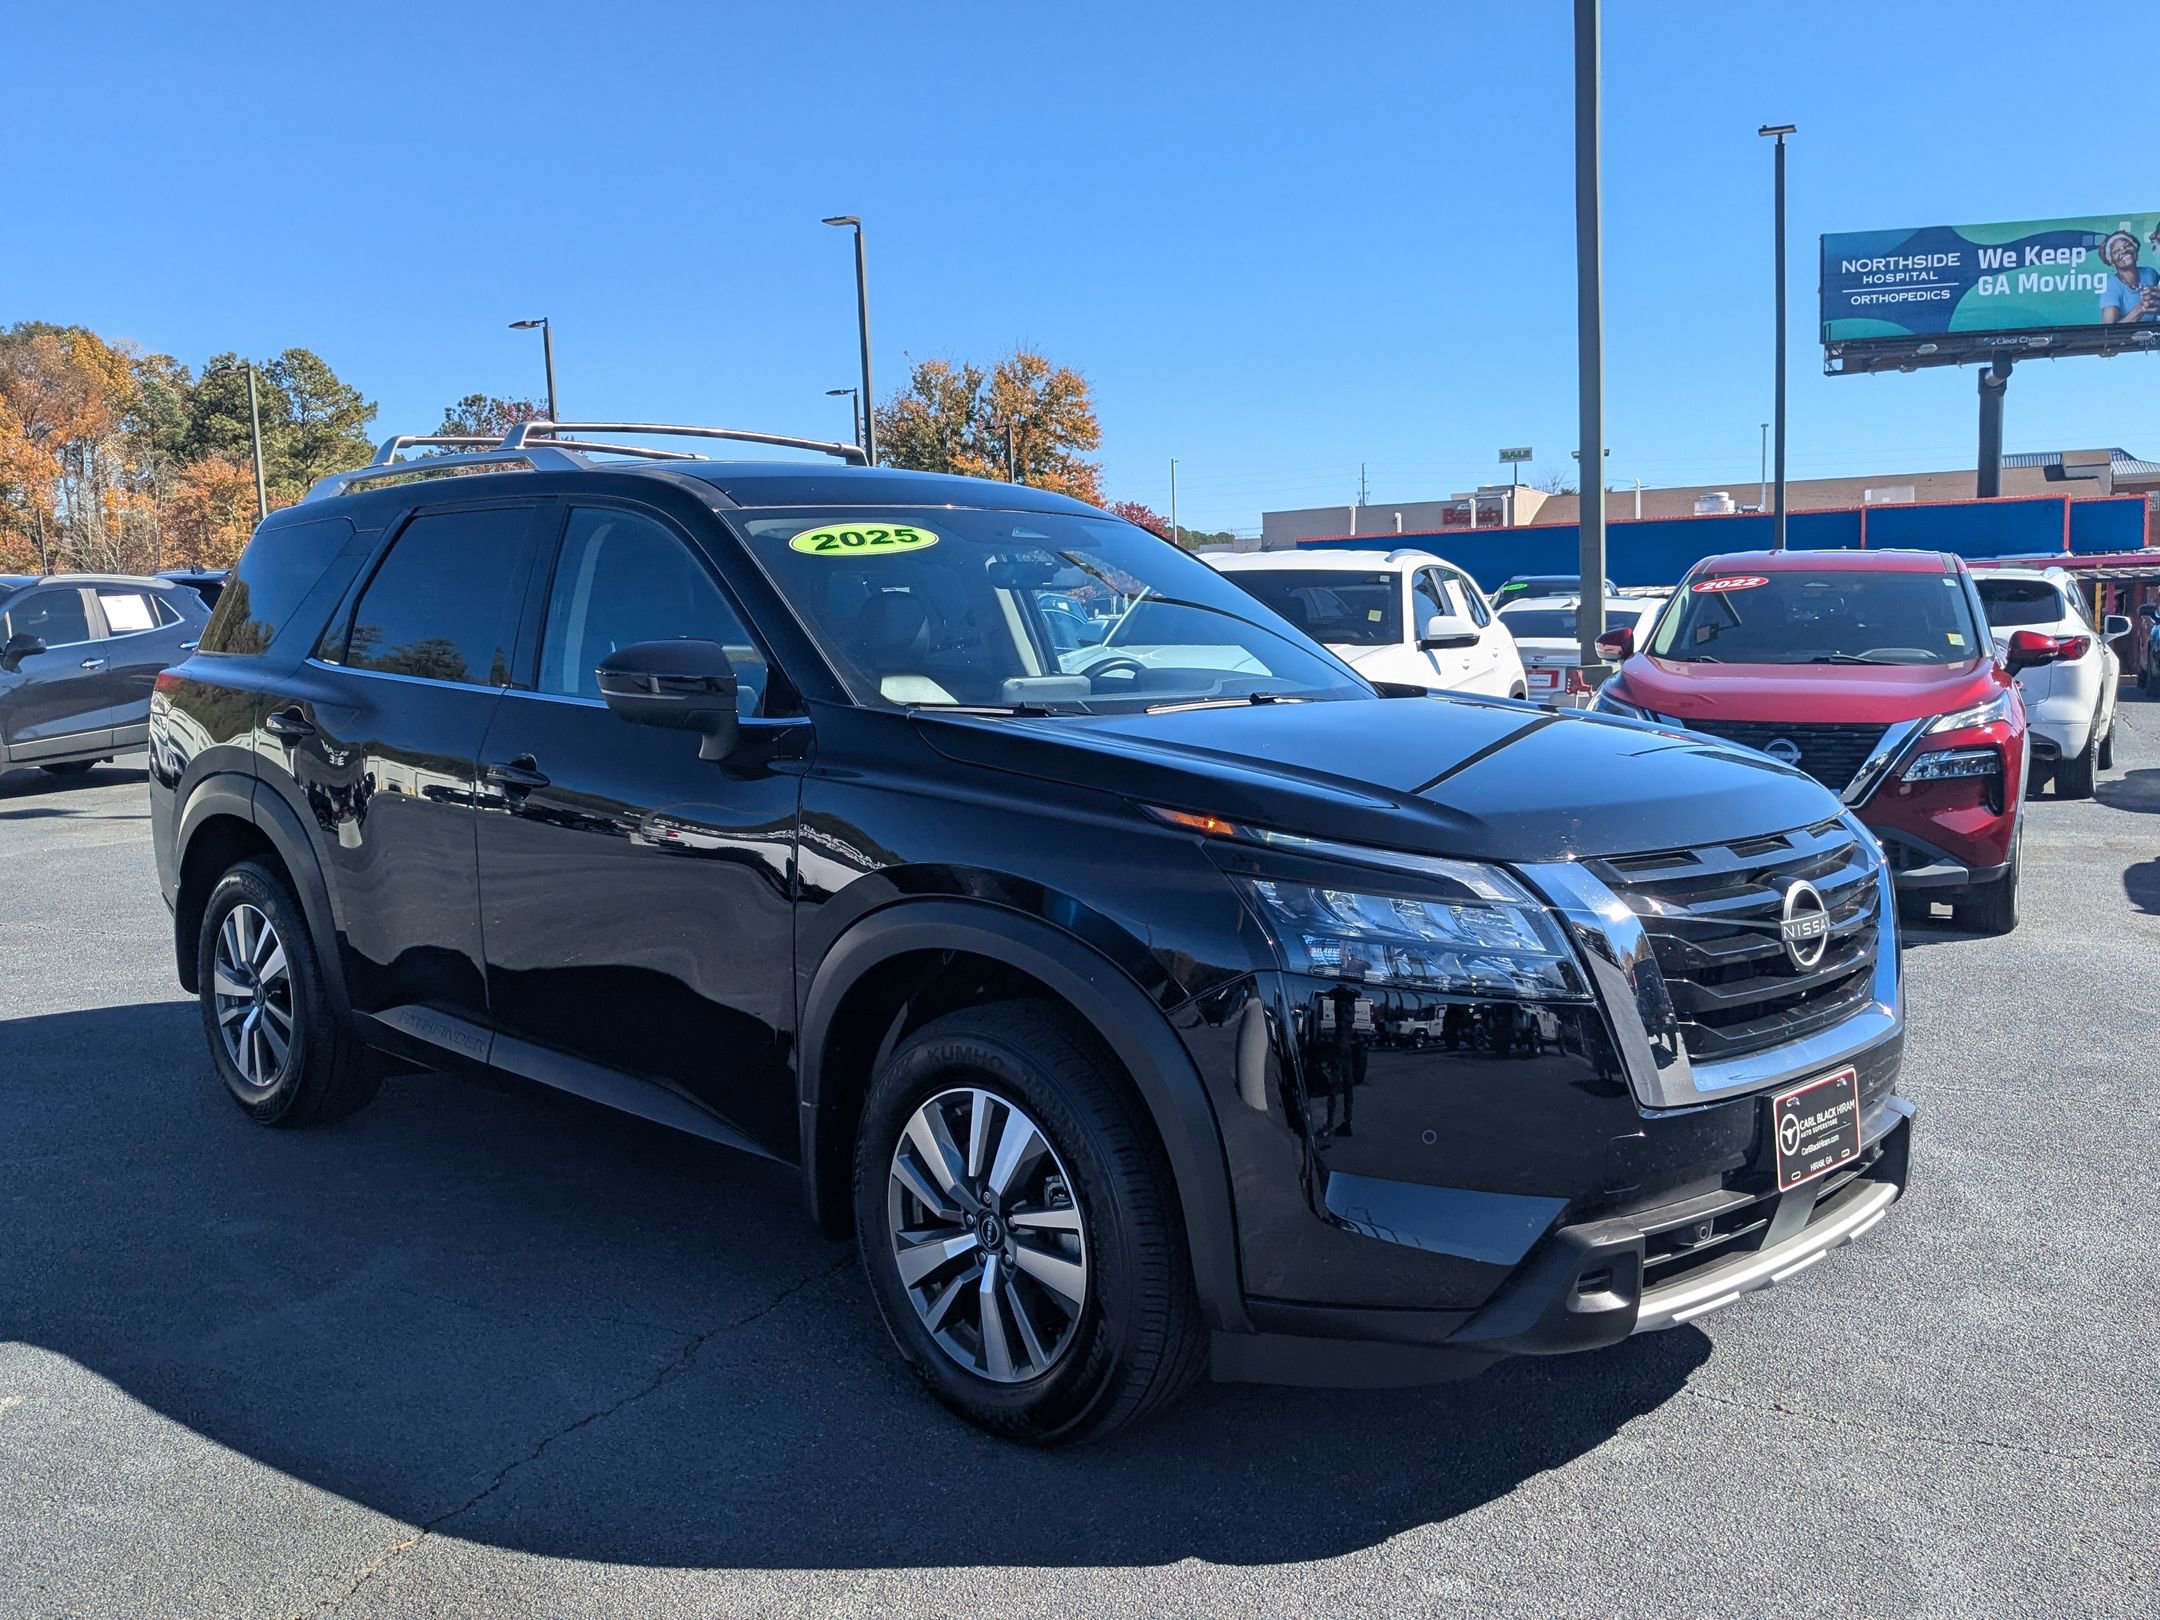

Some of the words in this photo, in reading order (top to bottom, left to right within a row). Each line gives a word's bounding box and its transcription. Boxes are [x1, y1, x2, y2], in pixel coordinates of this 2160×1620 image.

[1842, 253, 1961, 273] NORTHSIDE
[1978, 248, 2017, 269] We
[2024, 245, 2086, 267] Keep
[1863, 271, 1939, 284] HOSPITAL
[1978, 275, 2011, 296] GA
[2018, 269, 2108, 295] Moving
[1851, 289, 1951, 305] ORTHOPEDICS
[810, 528, 920, 551] 2025
[1699, 578, 1761, 591] 2022
[1800, 1116, 1817, 1130] CARL
[1816, 1106, 1837, 1124] BLACK
[1836, 1099, 1856, 1115] HIRAM
